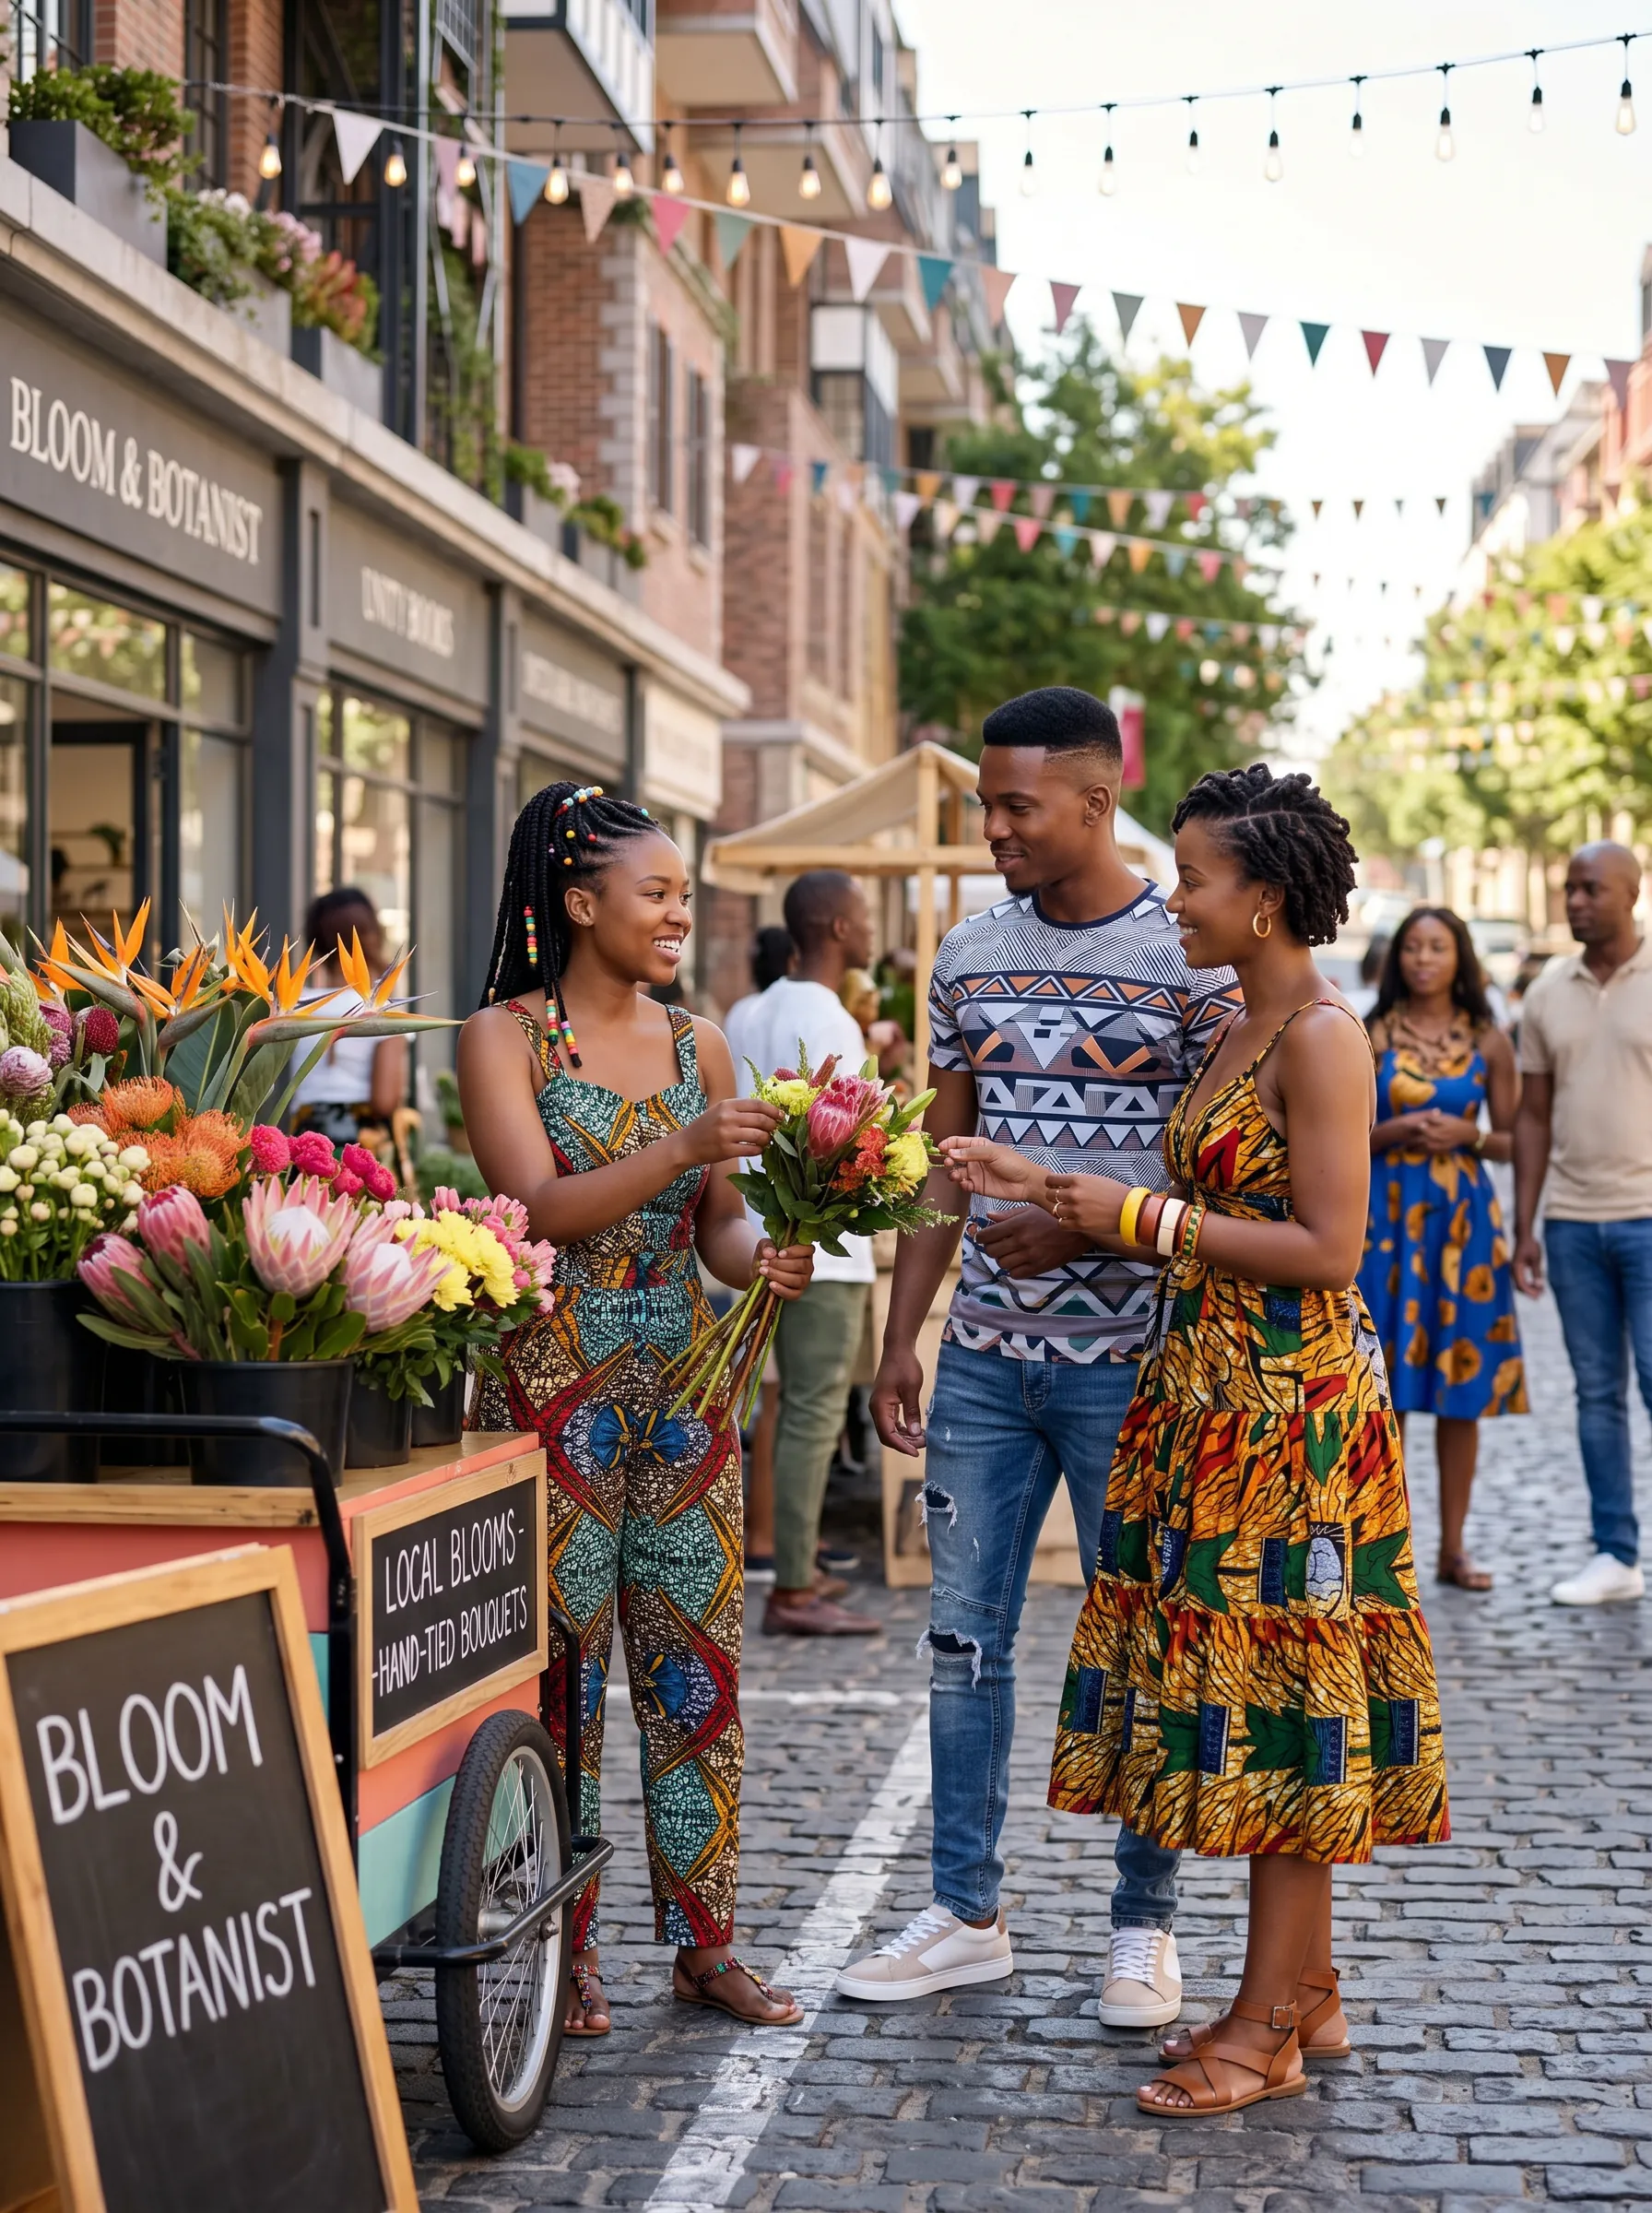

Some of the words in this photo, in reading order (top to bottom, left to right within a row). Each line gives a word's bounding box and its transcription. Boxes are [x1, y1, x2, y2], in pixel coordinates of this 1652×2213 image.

[10, 376, 116, 497] BLOOM
[120, 436, 143, 509] &
[147, 448, 263, 565] BOTANIST
[385, 1537, 443, 1614] LOCAL
[460, 1584, 527, 1659] BOUQUETS
[36, 1663, 264, 1825] BLOOM
[153, 1810, 203, 1912] &
[72, 1887, 316, 2073] BOTANIST
